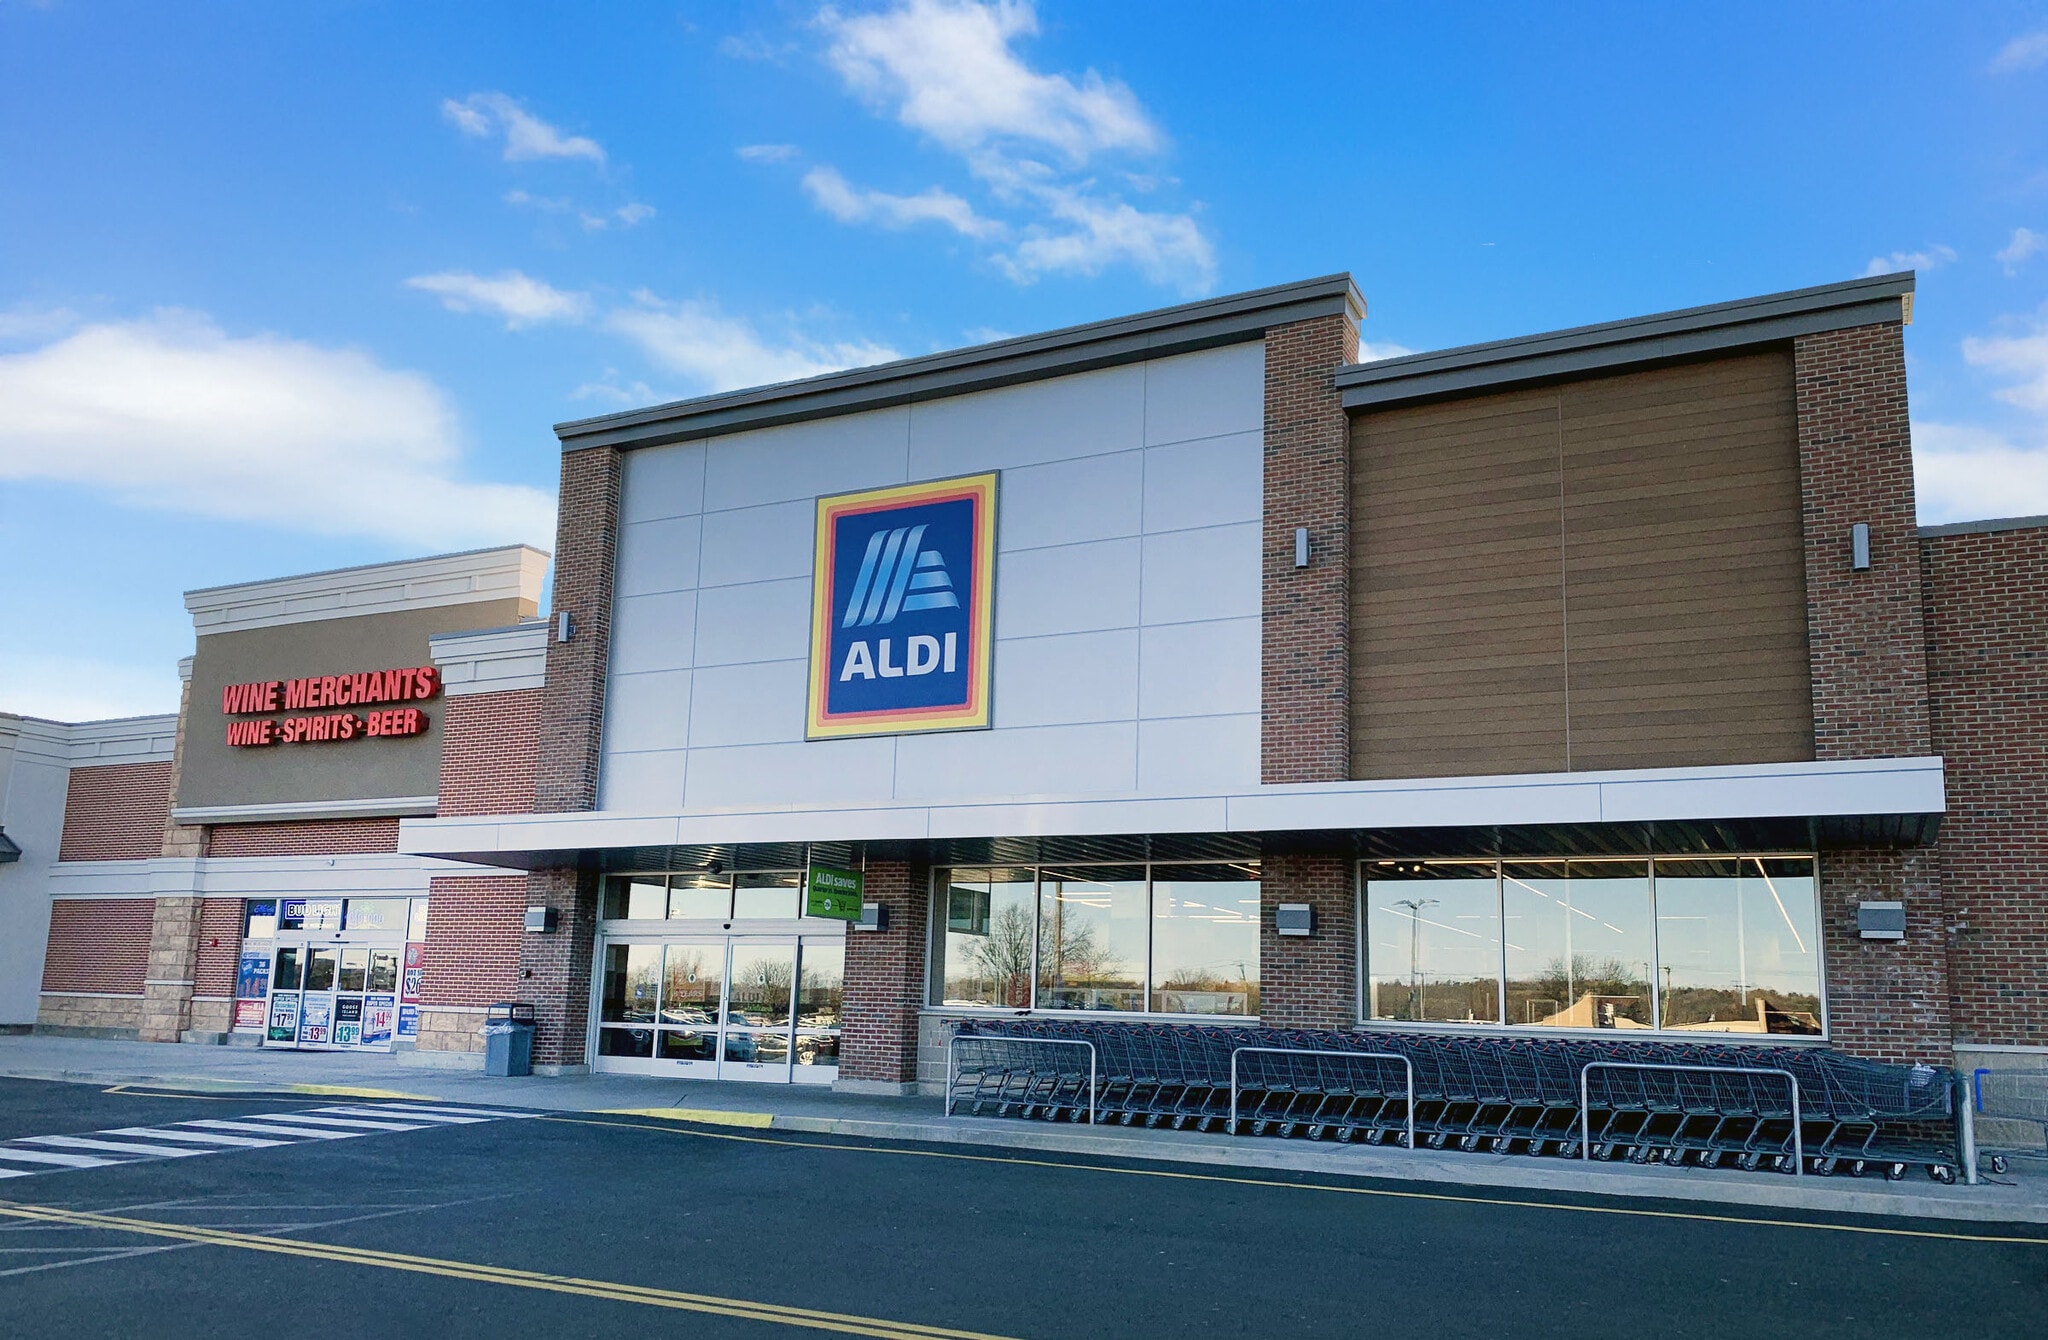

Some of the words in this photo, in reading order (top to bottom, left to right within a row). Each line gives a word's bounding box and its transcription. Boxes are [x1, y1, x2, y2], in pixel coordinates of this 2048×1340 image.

[840, 632, 957, 682] ALDI
[222, 681, 279, 715] WINE
[284, 666, 434, 710] MERCHANTS
[226, 720, 271, 746] WINE
[282, 713, 354, 743] SPIRITS
[367, 708, 418, 737] BEER
[816, 872, 834, 886] ALDI
[834, 877, 857, 889] saves
[287, 903, 311, 916] BUD
